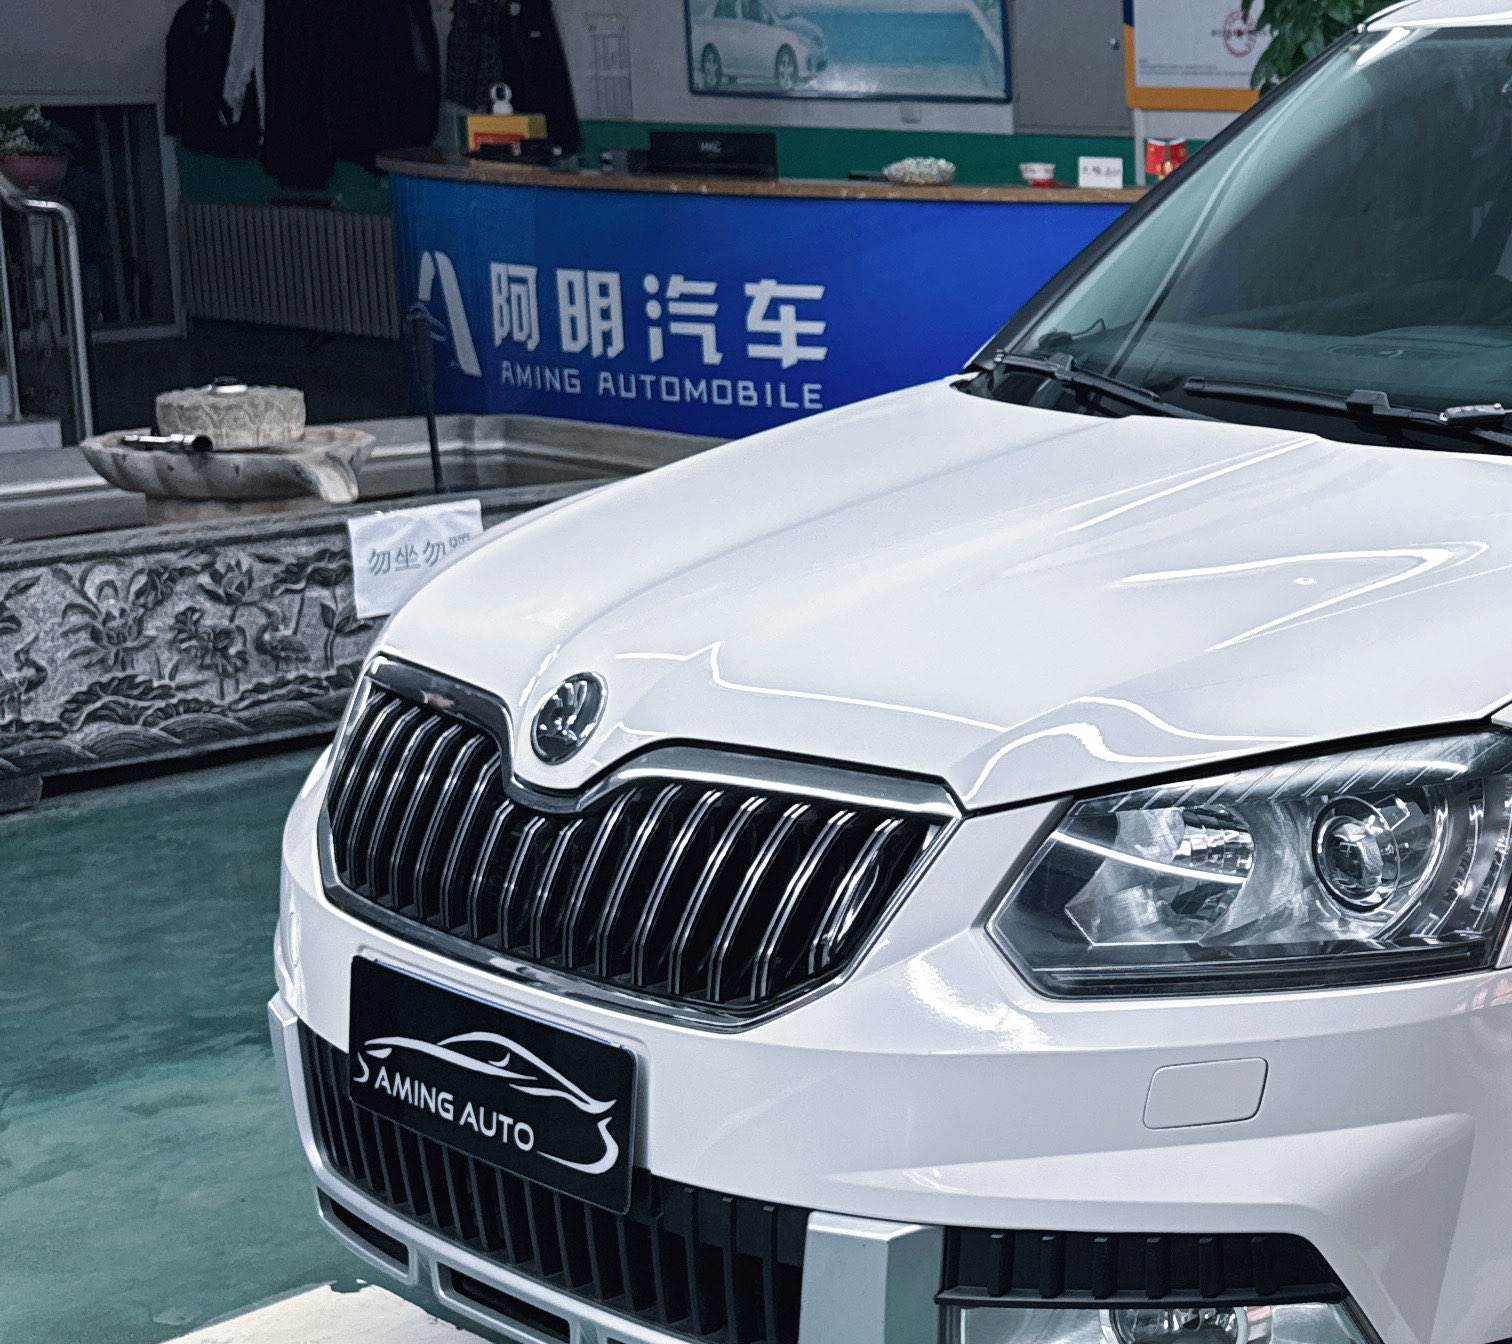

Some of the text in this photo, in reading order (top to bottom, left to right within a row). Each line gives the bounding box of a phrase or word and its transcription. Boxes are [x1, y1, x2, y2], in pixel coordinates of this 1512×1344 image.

[489, 260, 829, 370] 阿明汽车
[500, 359, 824, 410] AMING AUTOMOBILE
[374, 1066, 535, 1152] AMING AUTO
